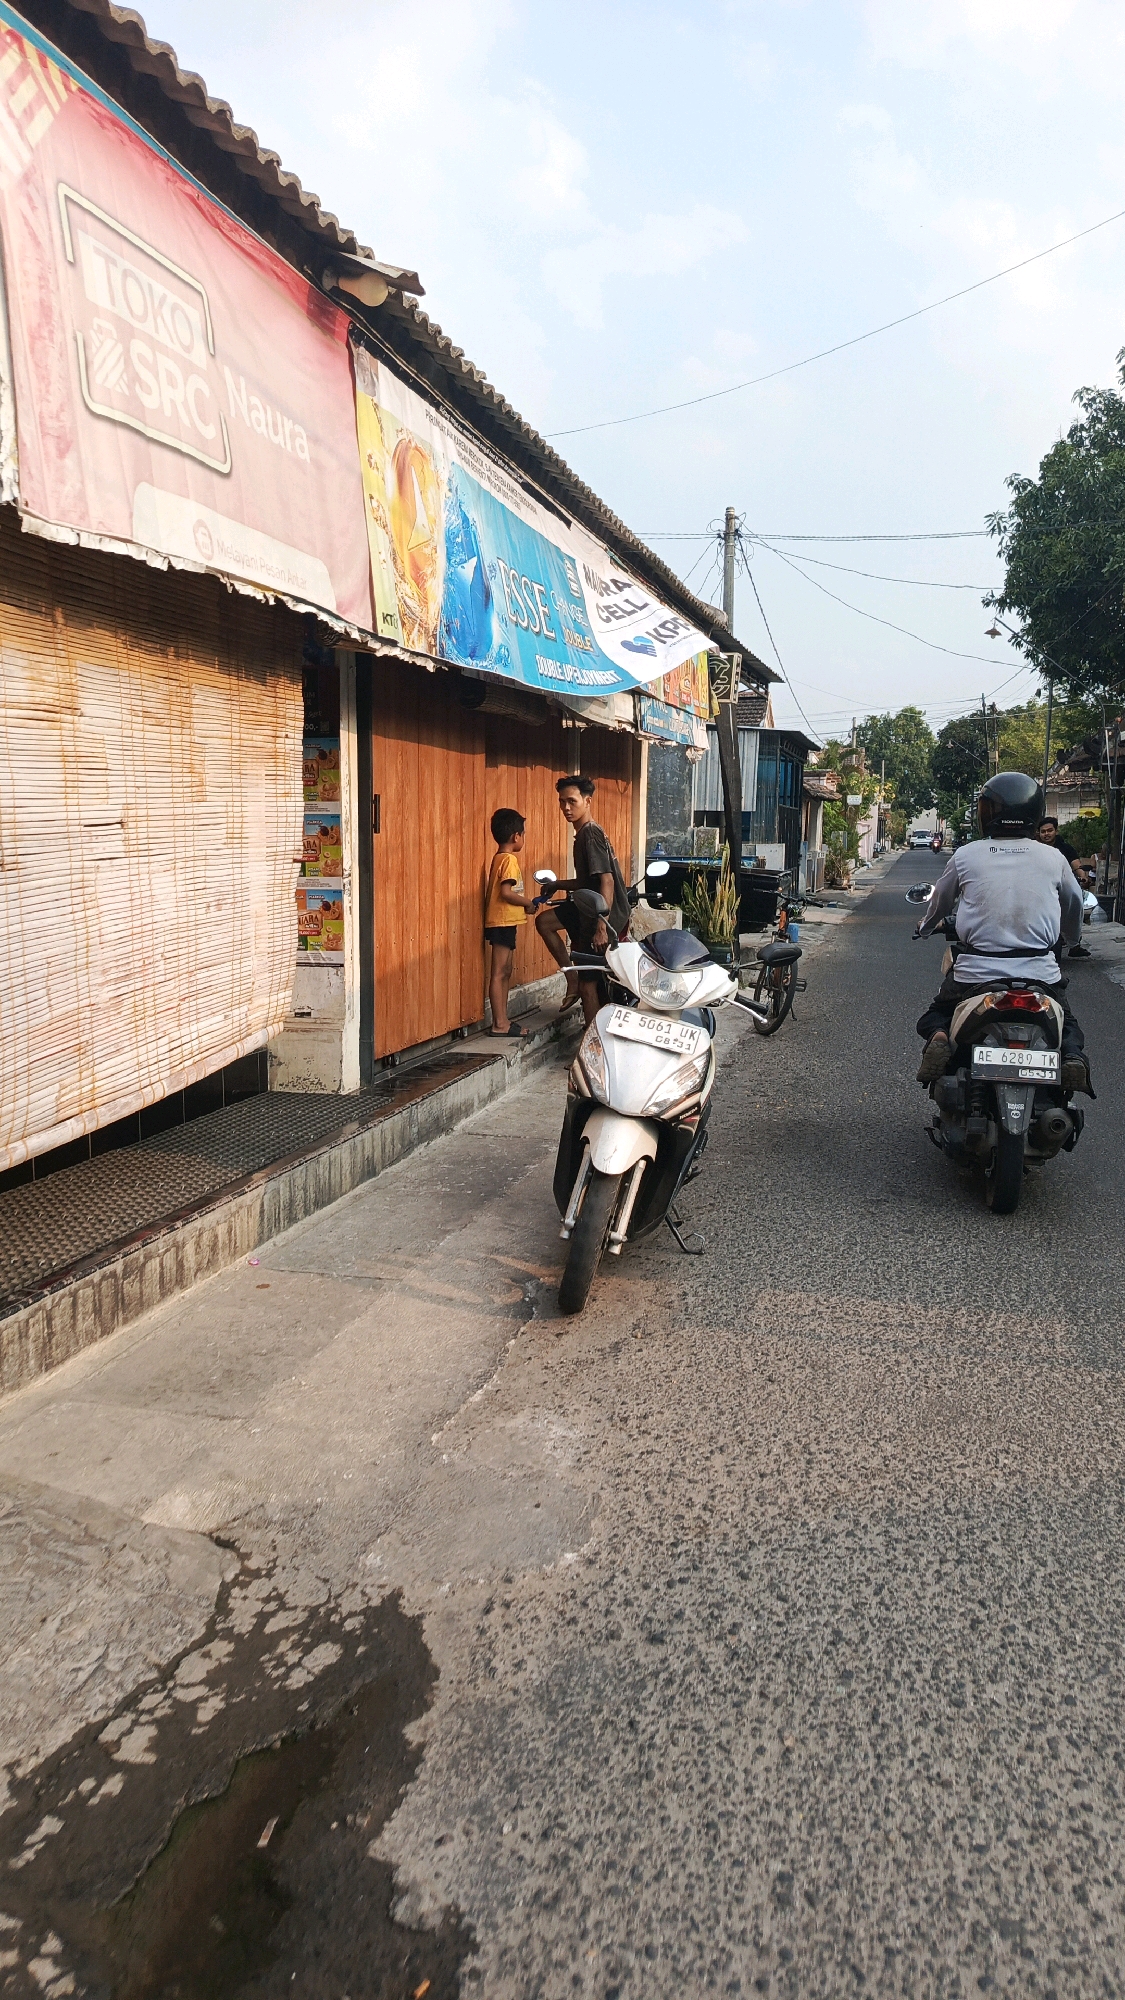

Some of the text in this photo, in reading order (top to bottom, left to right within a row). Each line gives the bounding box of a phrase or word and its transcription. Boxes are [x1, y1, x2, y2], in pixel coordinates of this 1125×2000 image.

[93, 244, 195, 355] TOKO
[129, 338, 217, 440] SRC
[223, 365, 311, 464] Naura
[216, 538, 258, 570] Melayani
[259, 556, 286, 580] Pesan
[497, 557, 557, 643] ESSE
[596, 598, 650, 624] CELL
[535, 654, 566, 681] DOUBLE
[614, 1009, 698, 1041] AE 5061 UK
[978, 1050, 1056, 1067] AE 6289 TK
